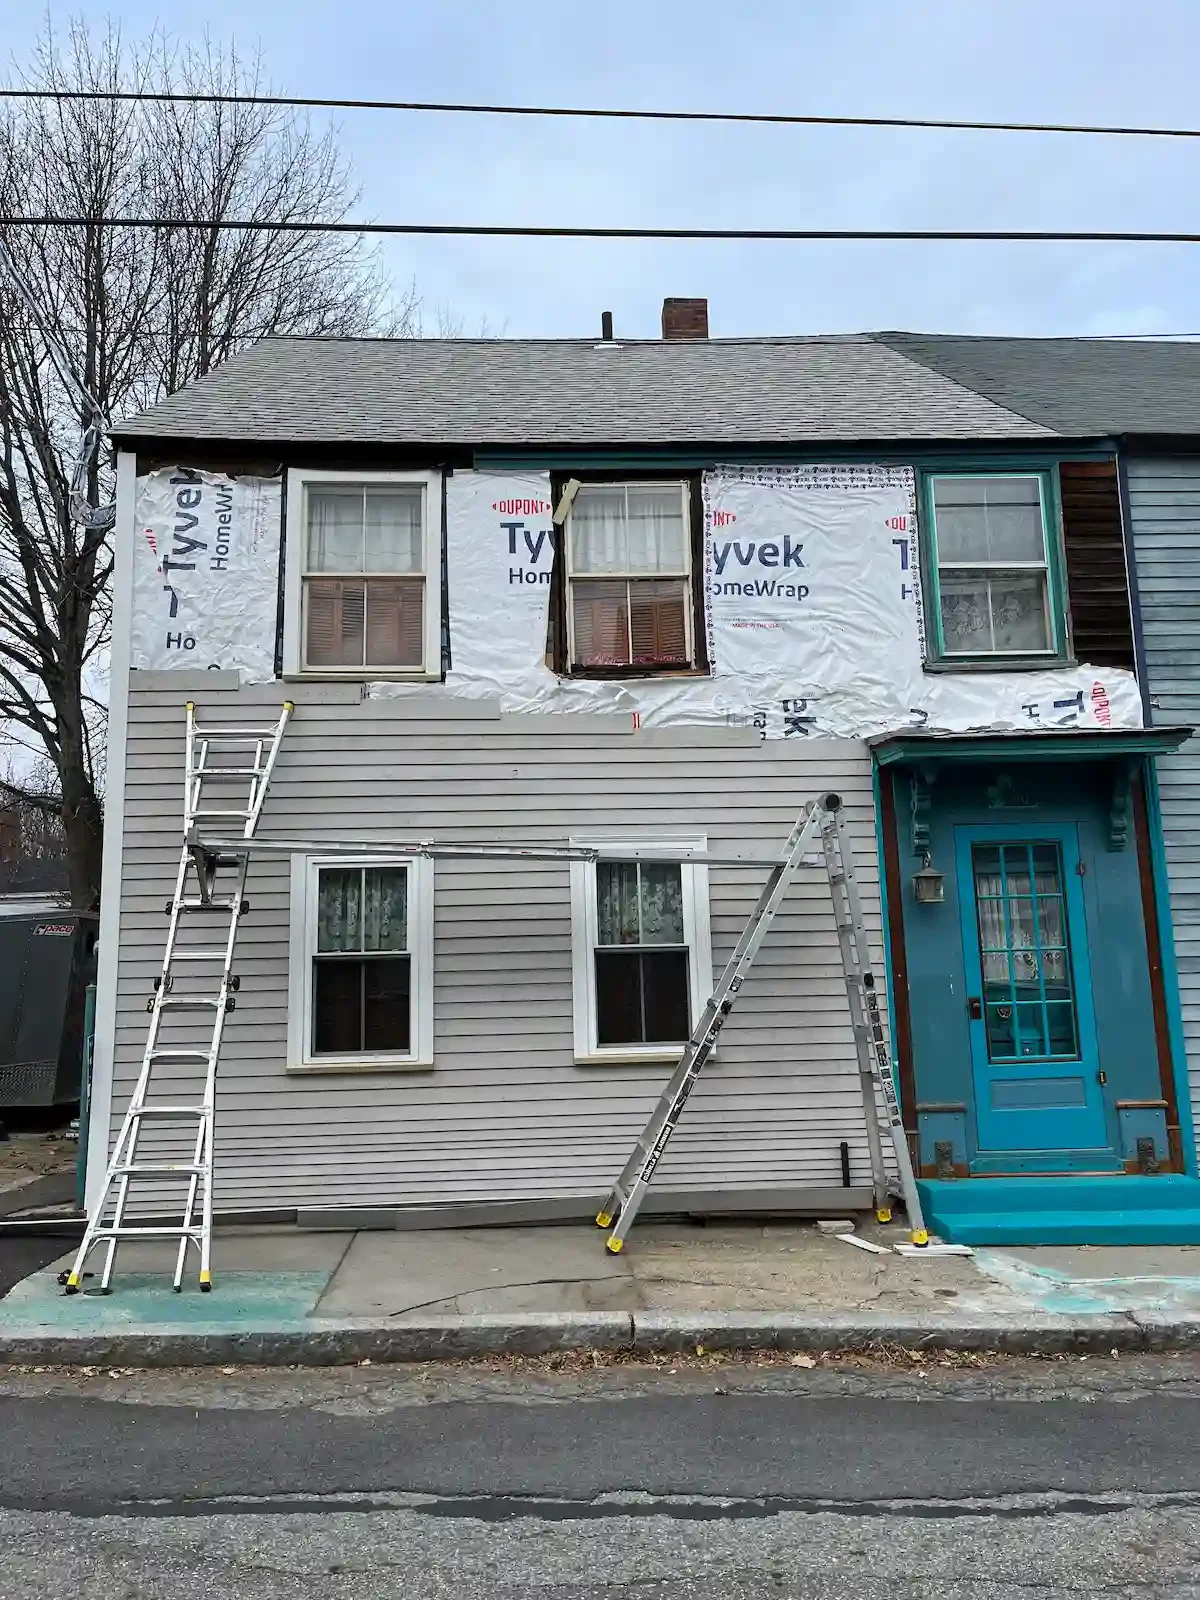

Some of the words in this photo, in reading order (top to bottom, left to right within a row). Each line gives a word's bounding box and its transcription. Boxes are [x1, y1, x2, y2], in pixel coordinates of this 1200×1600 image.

[500, 499, 544, 515] DUPONT
[713, 535, 806, 575] yvek
[713, 579, 810, 601] omeWrap
[166, 631, 197, 650] Ho
